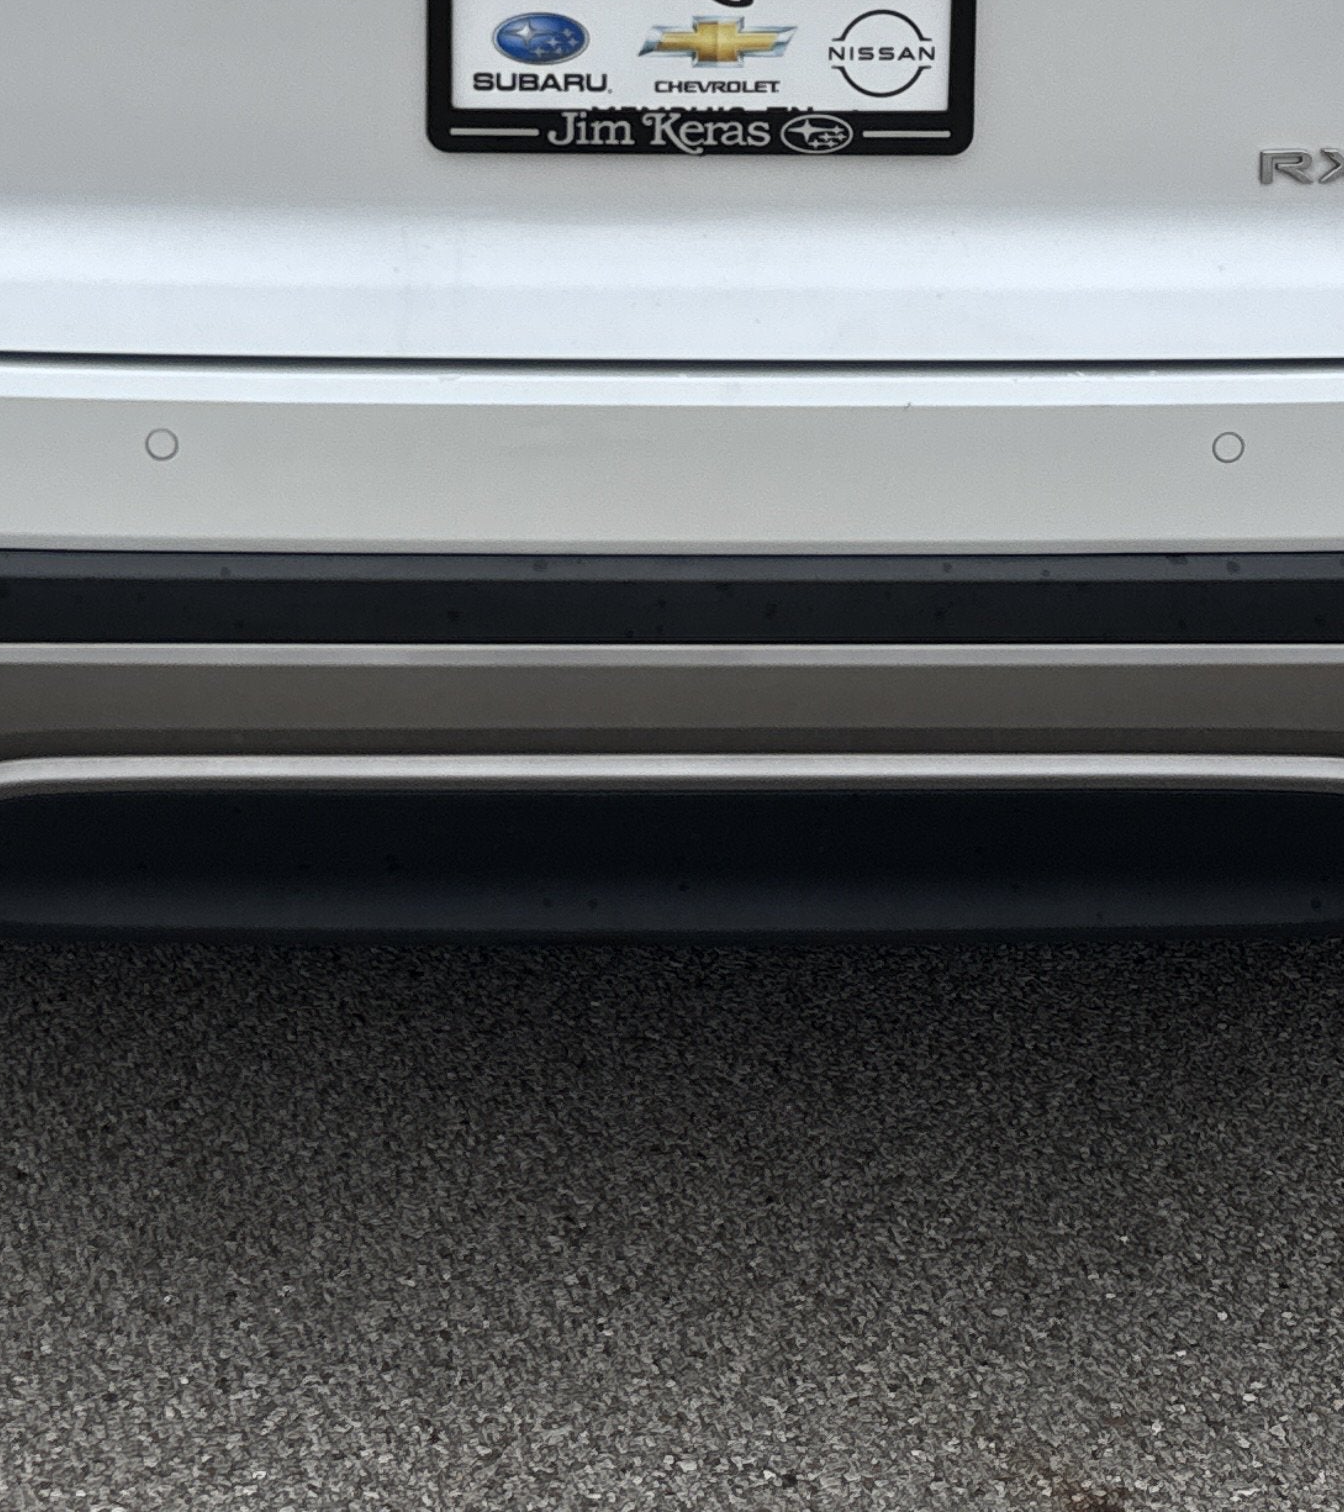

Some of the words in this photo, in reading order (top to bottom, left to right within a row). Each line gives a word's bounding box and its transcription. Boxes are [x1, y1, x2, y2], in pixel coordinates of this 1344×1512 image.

[828, 46, 935, 61] NISSAN
[473, 73, 608, 92] SUBARU
[654, 81, 780, 93] CHEVROLET
[547, 111, 635, 145] Jim
[642, 112, 771, 154] Keras
